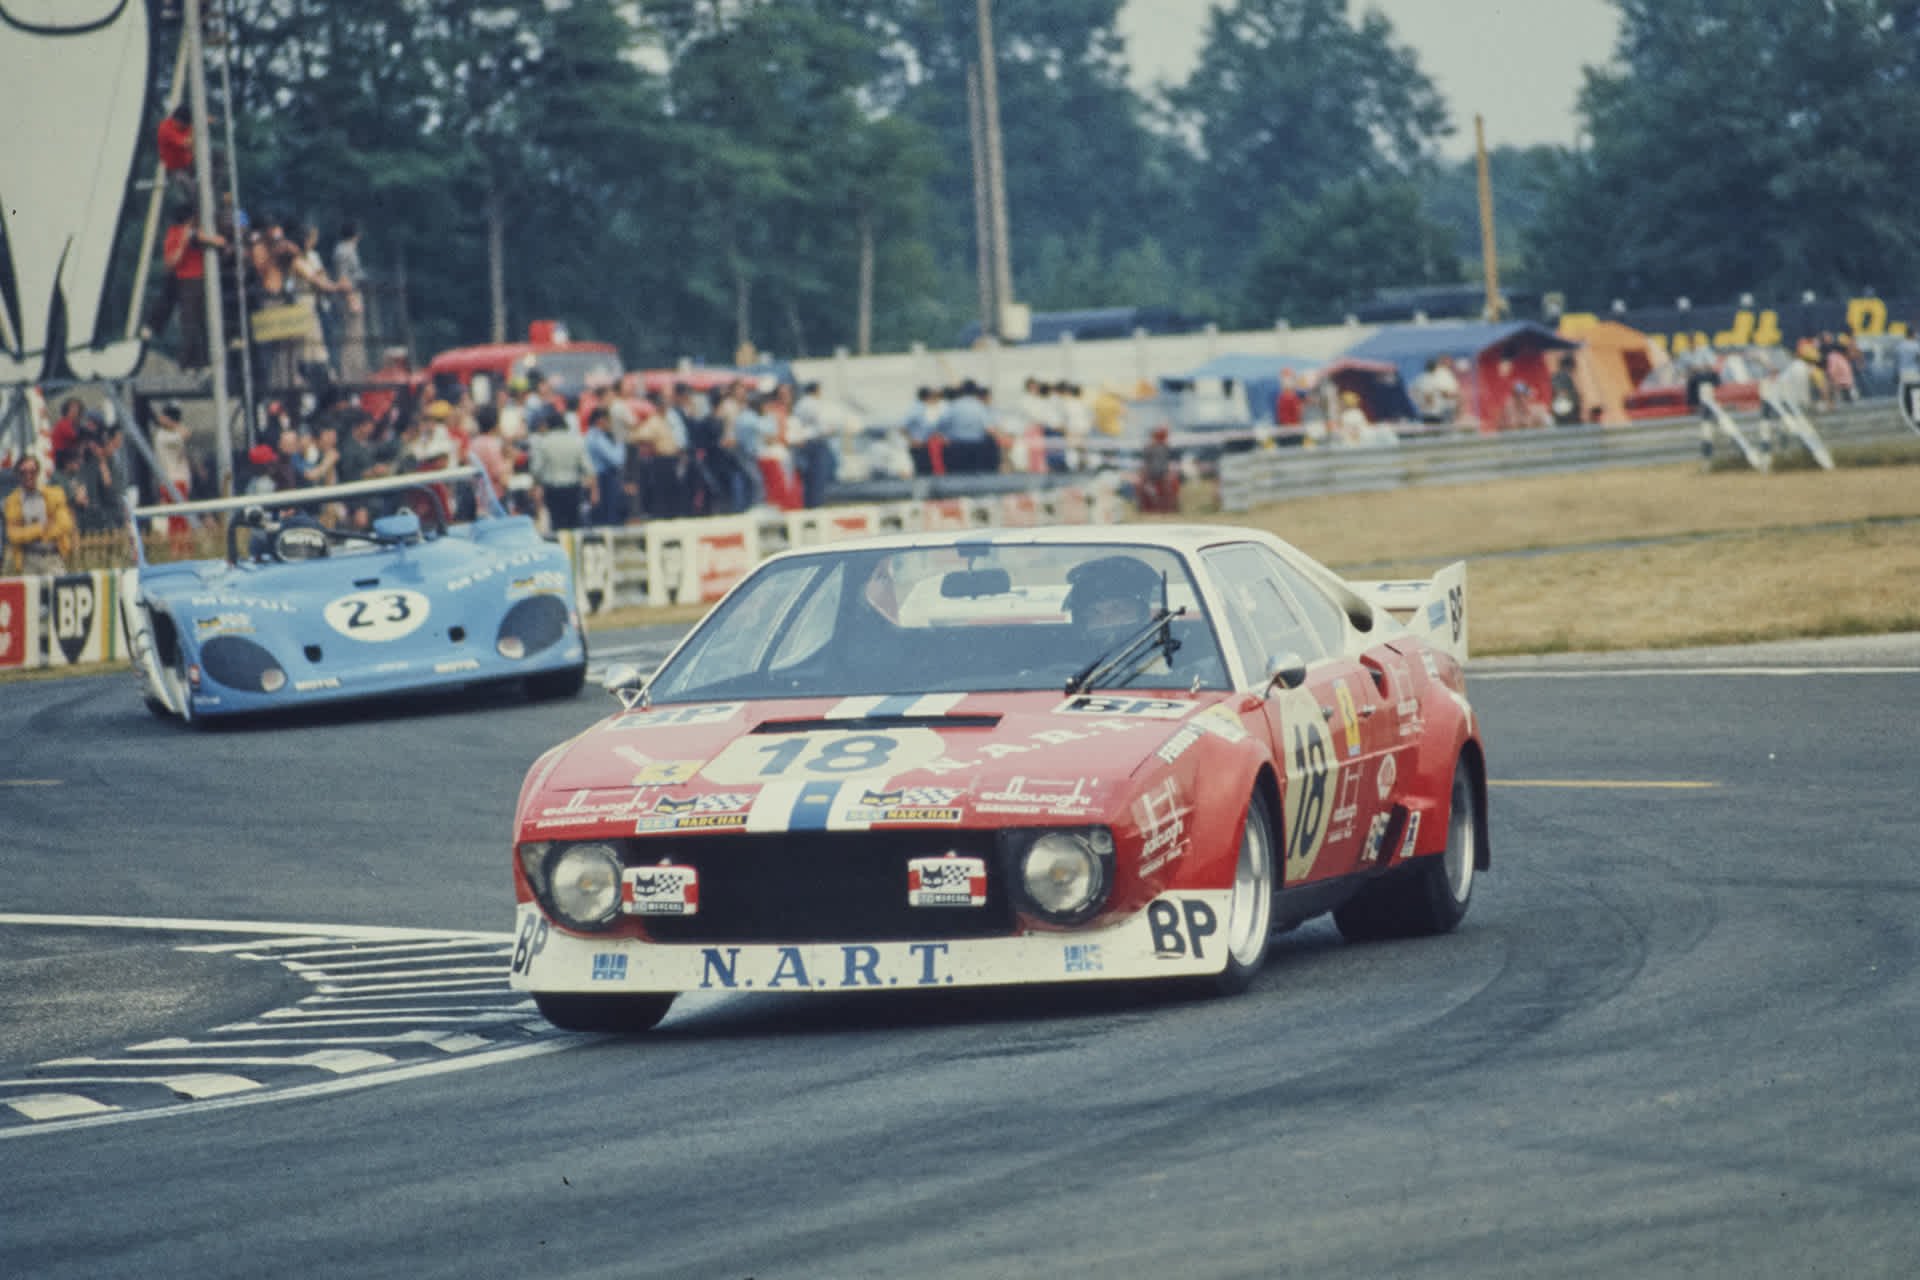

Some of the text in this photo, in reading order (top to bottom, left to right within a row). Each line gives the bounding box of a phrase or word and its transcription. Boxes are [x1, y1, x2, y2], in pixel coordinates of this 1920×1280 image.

[58, 584, 93, 638] BP
[342, 594, 410, 628] 23
[611, 704, 735, 728] BP
[1064, 697, 1185, 713] BP
[757, 735, 899, 776] 18
[1287, 722, 1328, 860] 18
[678, 814, 746, 828] MARCHAL
[512, 912, 548, 976] BP
[1147, 898, 1218, 960] BP
[699, 943, 954, 988] N.A.R.T.
